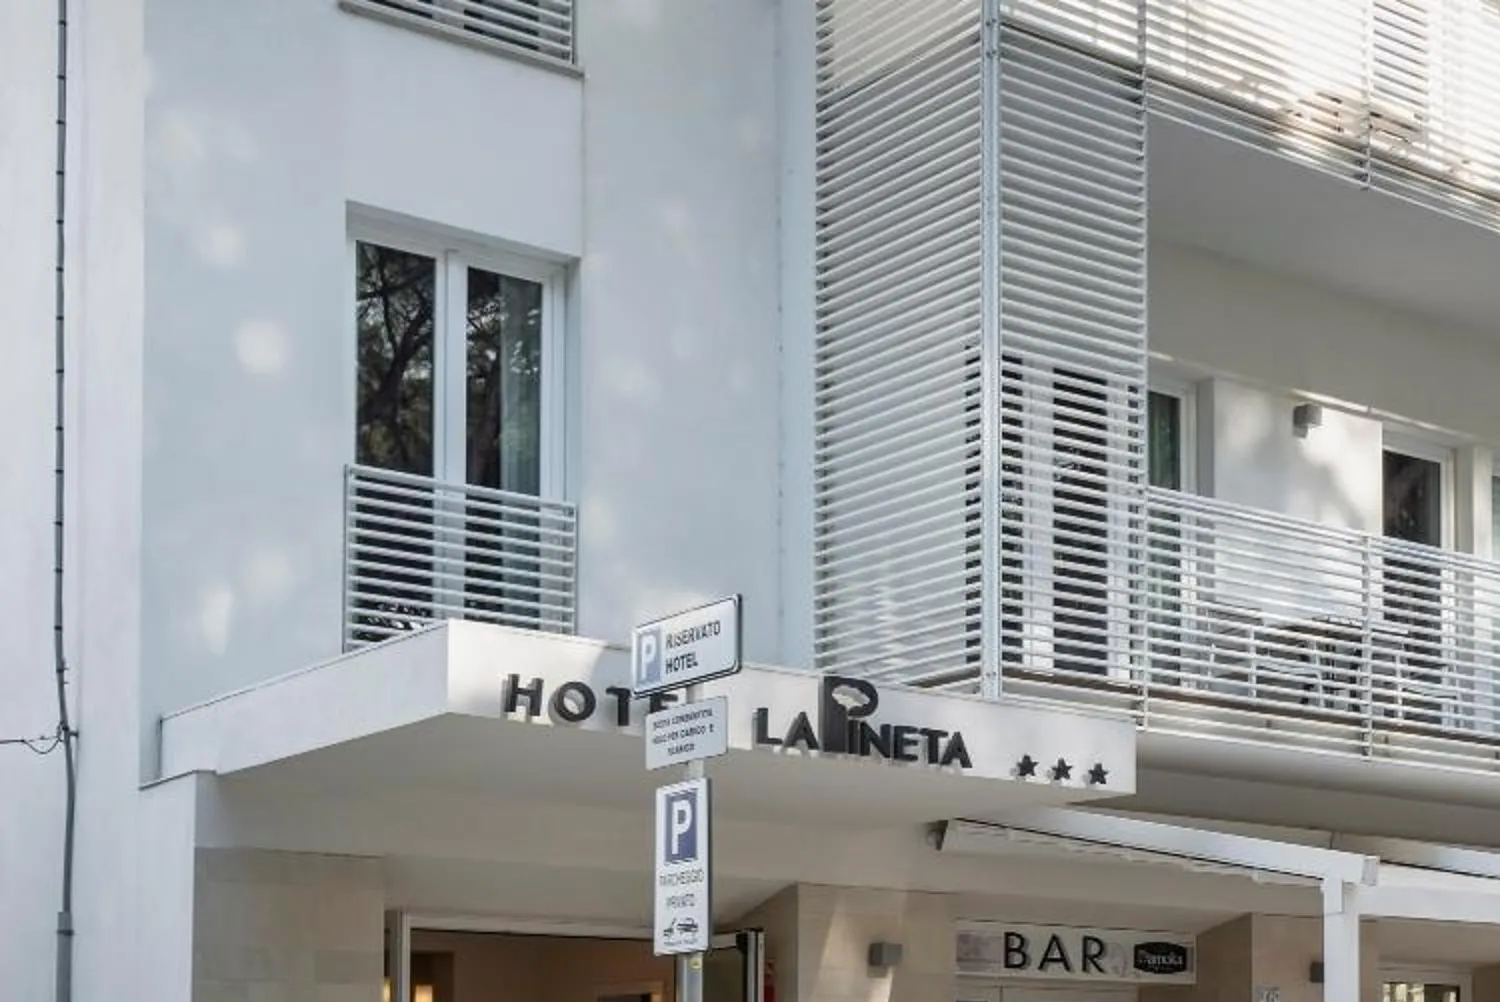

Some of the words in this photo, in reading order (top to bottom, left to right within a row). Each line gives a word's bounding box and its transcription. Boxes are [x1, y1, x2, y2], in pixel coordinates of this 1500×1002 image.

[641, 633, 657, 681] P
[665, 620, 721, 649] RISERVATO
[665, 652, 699, 675] HOTEL
[503, 673, 679, 727] HOTE
[756, 707, 820, 751] LA
[822, 675, 973, 769] PINETA
[671, 799, 693, 856] P
[1003, 931, 1105, 974] BAR
